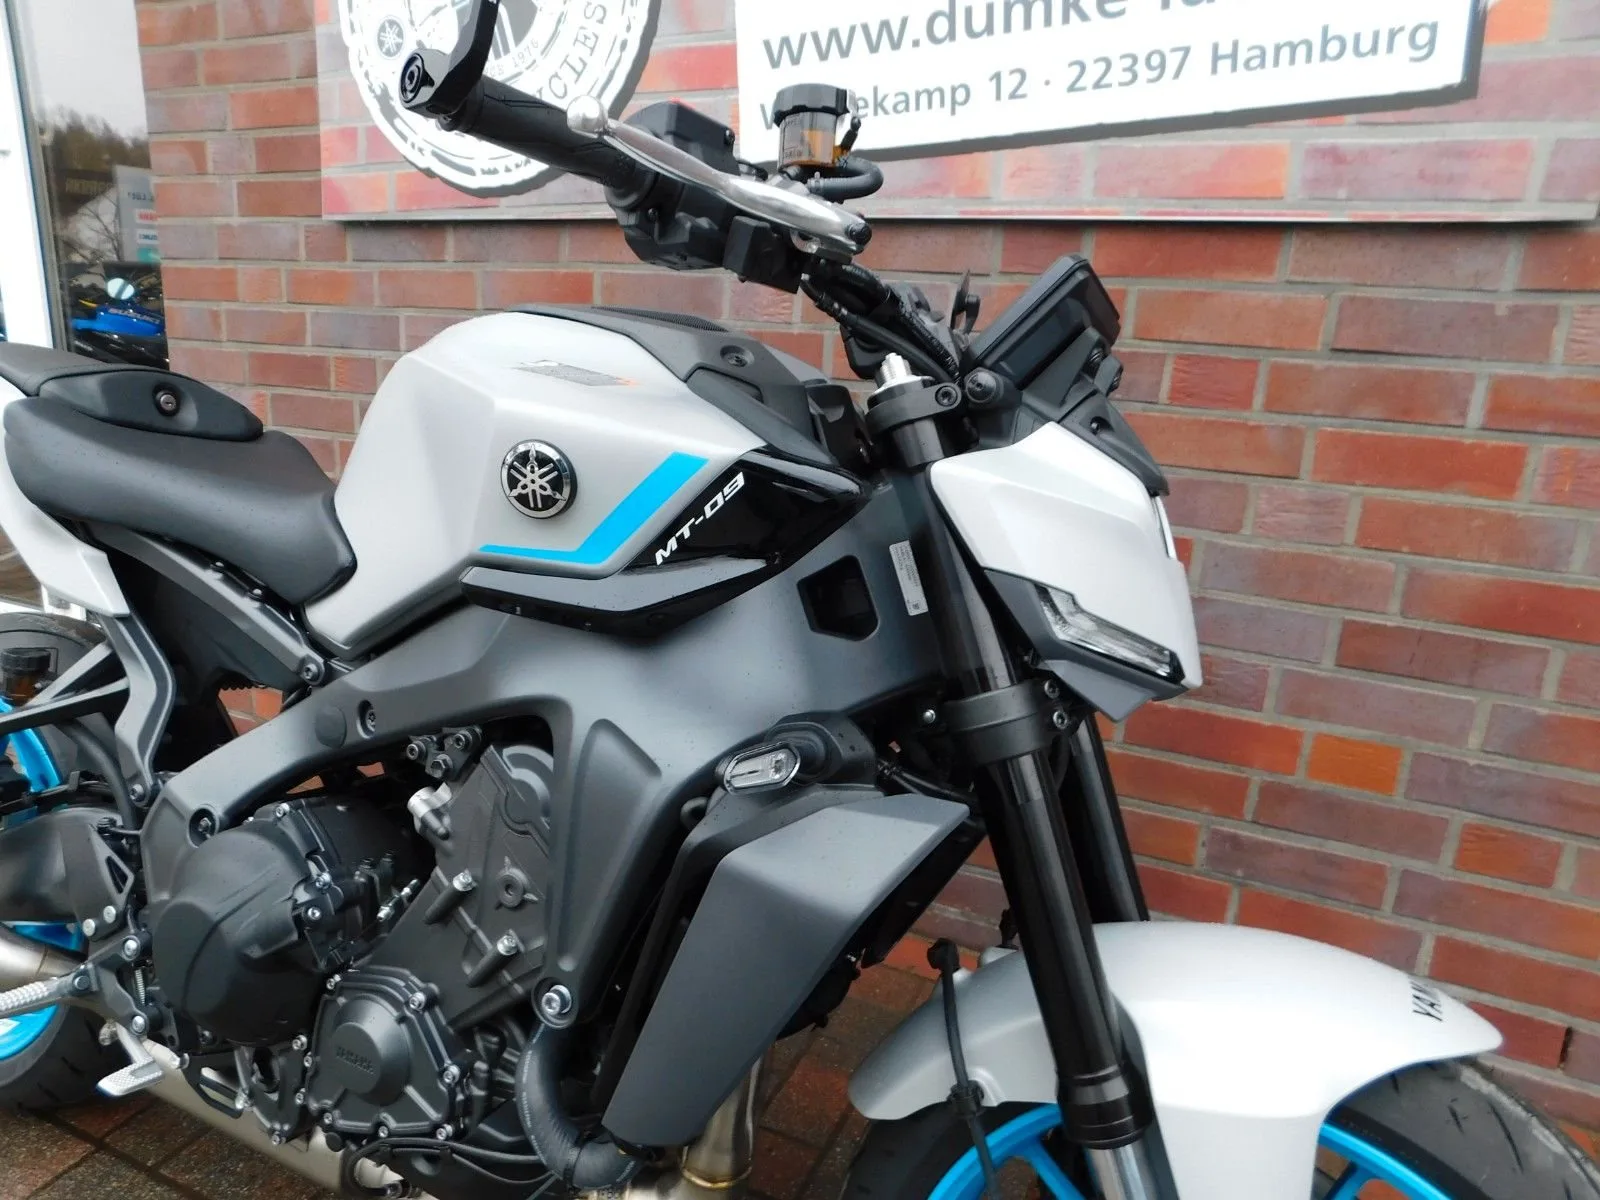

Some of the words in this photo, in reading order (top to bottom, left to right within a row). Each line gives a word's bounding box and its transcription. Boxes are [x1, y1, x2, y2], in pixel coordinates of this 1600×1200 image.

[988, 67, 1028, 101] 12
[1066, 45, 1192, 93] 22397
[1210, 20, 1439, 76] Hamburg
[655, 471, 745, 566] MT-09
